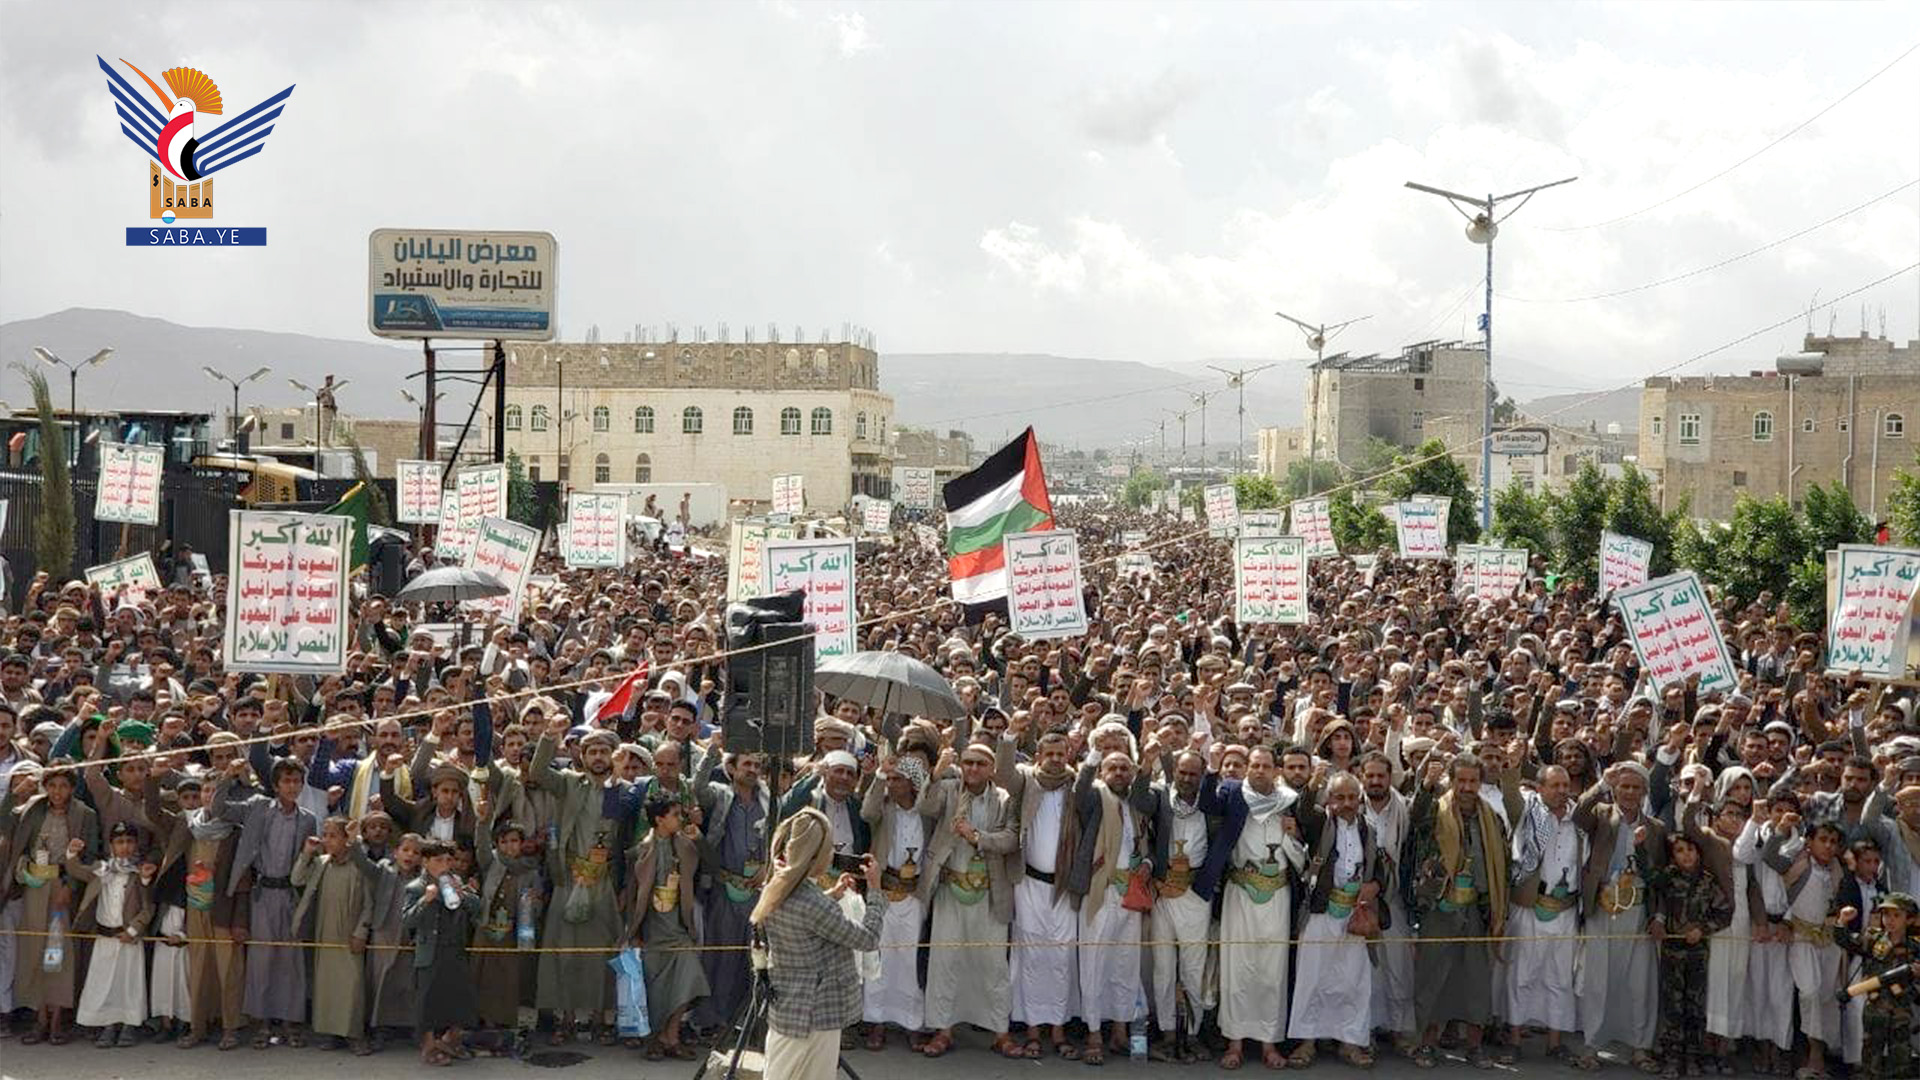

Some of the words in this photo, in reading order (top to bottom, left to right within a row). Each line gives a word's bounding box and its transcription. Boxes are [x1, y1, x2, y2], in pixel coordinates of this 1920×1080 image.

[394, 237, 461, 264] اليابان
[467, 239, 537, 264] معرض
[384, 268, 474, 292] والاستيراد
[479, 269, 542, 294] للتجارة
[242, 518, 302, 550] أكبر
[306, 522, 342, 546] الله
[1013, 538, 1056, 564] أكبر
[1054, 538, 1072, 555] الله
[1244, 540, 1278, 560] أكبر
[1279, 541, 1300, 556] الله
[243, 552, 294, 573] لأمريكا
[298, 556, 339, 574] الموت
[775, 549, 818, 579] أكبر
[820, 552, 848, 570] الله
[1848, 555, 1895, 582] أكبر
[1632, 591, 1666, 623] أكبر
[1670, 586, 1697, 606] الله
[240, 607, 276, 626] اليهود
[280, 608, 300, 626] على
[306, 607, 337, 624] اللعنة
[239, 630, 288, 659] للإسلام
[292, 630, 336, 658] النصر
